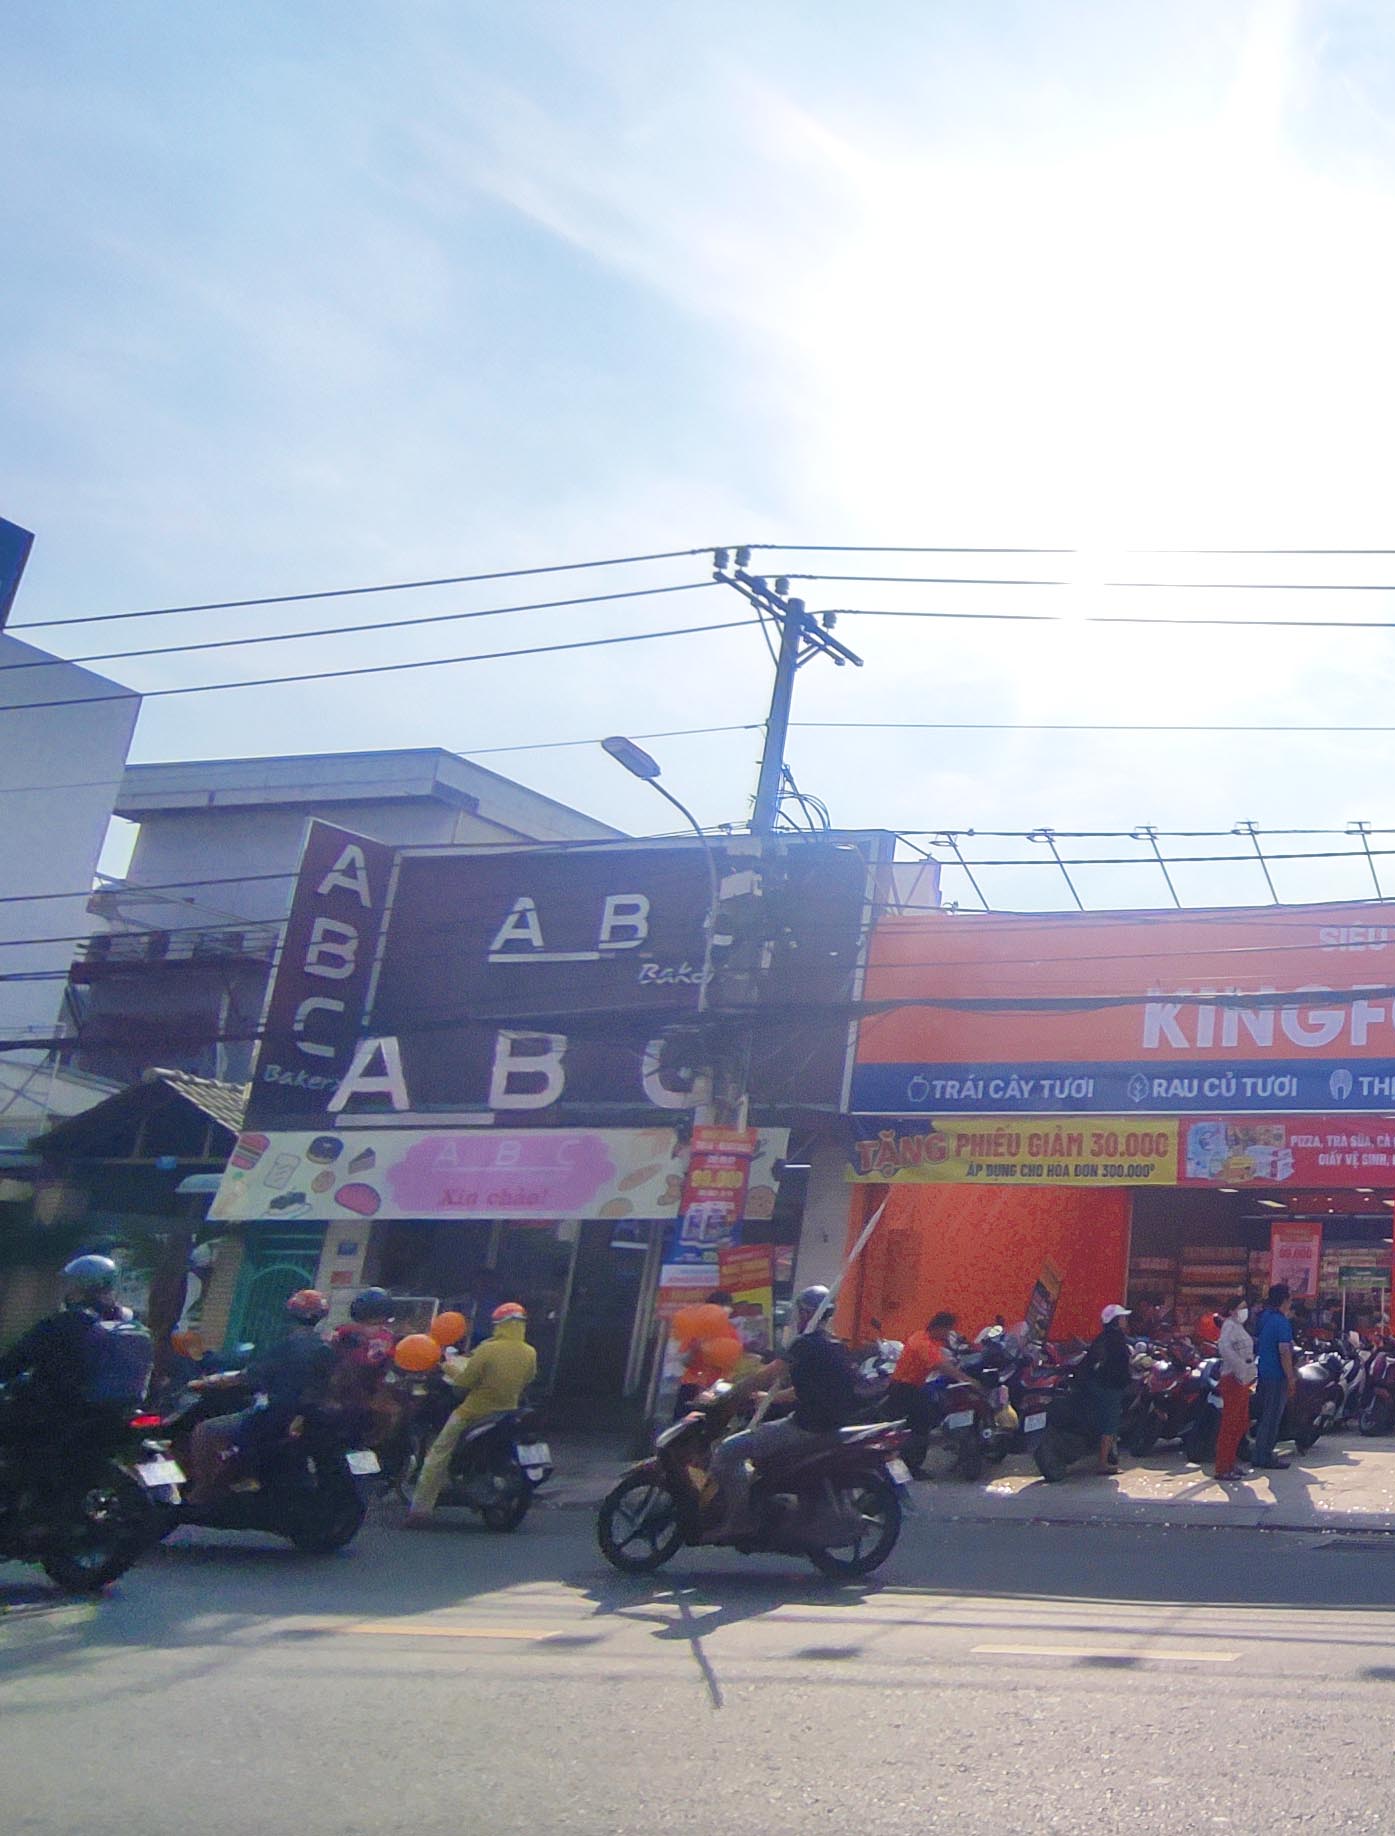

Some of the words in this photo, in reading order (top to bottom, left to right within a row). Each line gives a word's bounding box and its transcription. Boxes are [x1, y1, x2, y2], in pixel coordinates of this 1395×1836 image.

[932, 1074, 984, 1099] TRÁI
[988, 1075, 1033, 1099] CÂY
[1040, 1077, 1096, 1098] TƯƠI
[1152, 1077, 1199, 1098] RAU
[1203, 1071, 1237, 1097] CỦ
[1241, 1075, 1298, 1097] TƯƠI
[1089, 1131, 1170, 1158] 30.000
